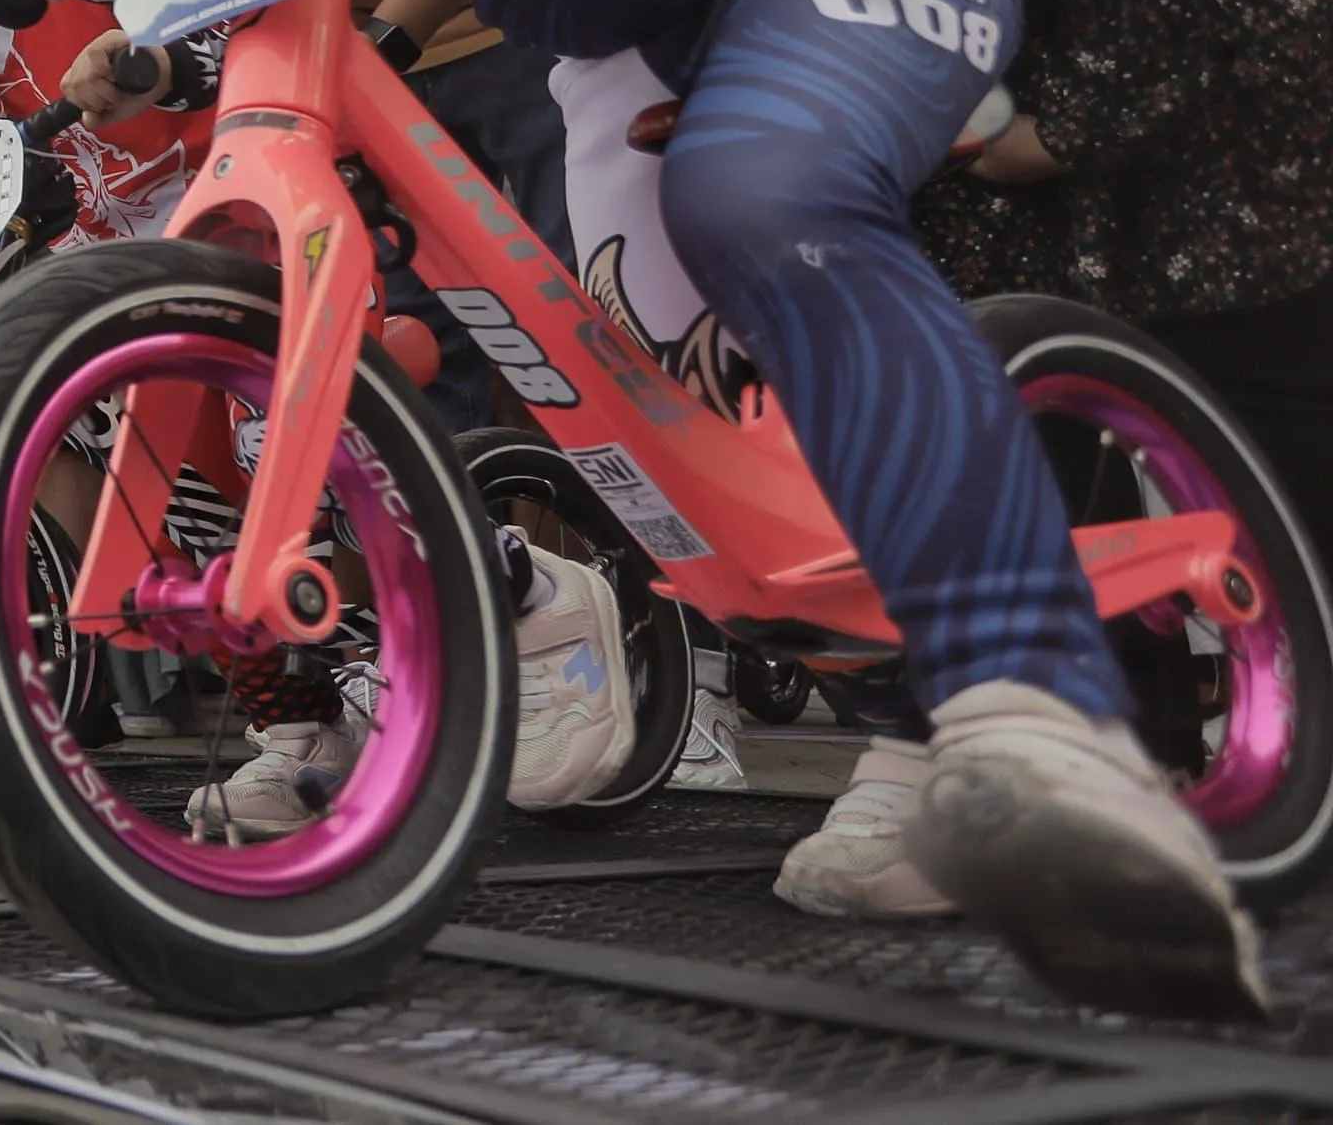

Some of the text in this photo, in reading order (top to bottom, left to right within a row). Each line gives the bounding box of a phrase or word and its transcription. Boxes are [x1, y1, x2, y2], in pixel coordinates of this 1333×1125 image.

[435, 287, 581, 408] 008
[575, 453, 639, 485] SNI
[18, 650, 131, 832] XPUSH
